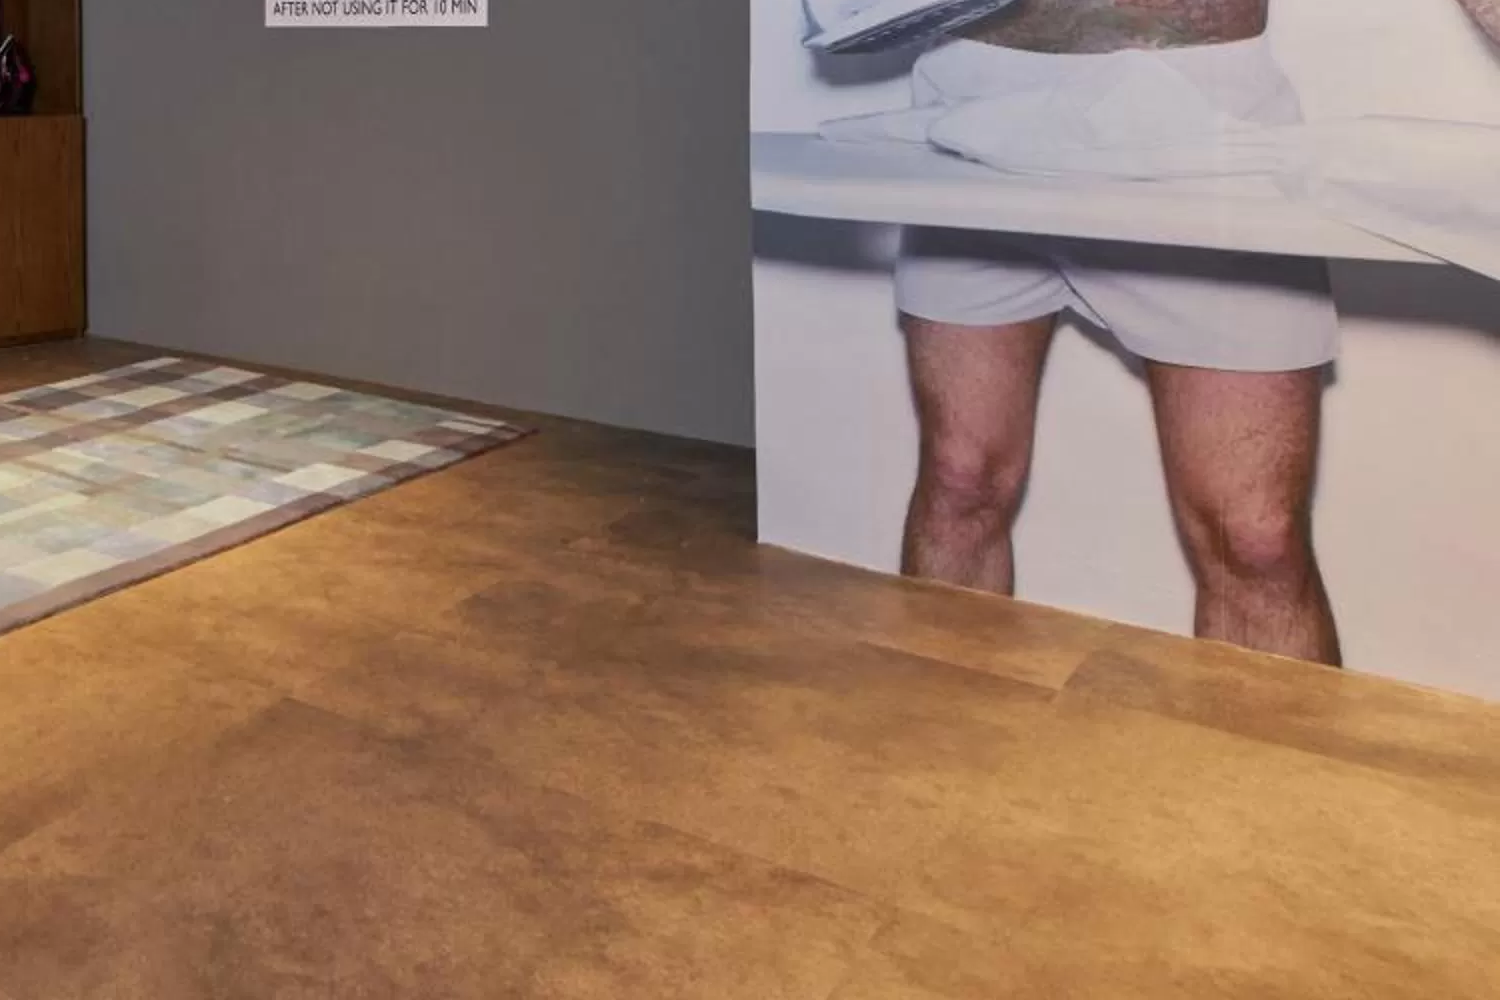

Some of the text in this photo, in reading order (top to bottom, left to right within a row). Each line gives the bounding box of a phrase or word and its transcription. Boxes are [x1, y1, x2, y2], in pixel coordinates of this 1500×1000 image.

[273, 0, 478, 17] AFTER NOT USING IT FOR 10 MIN
